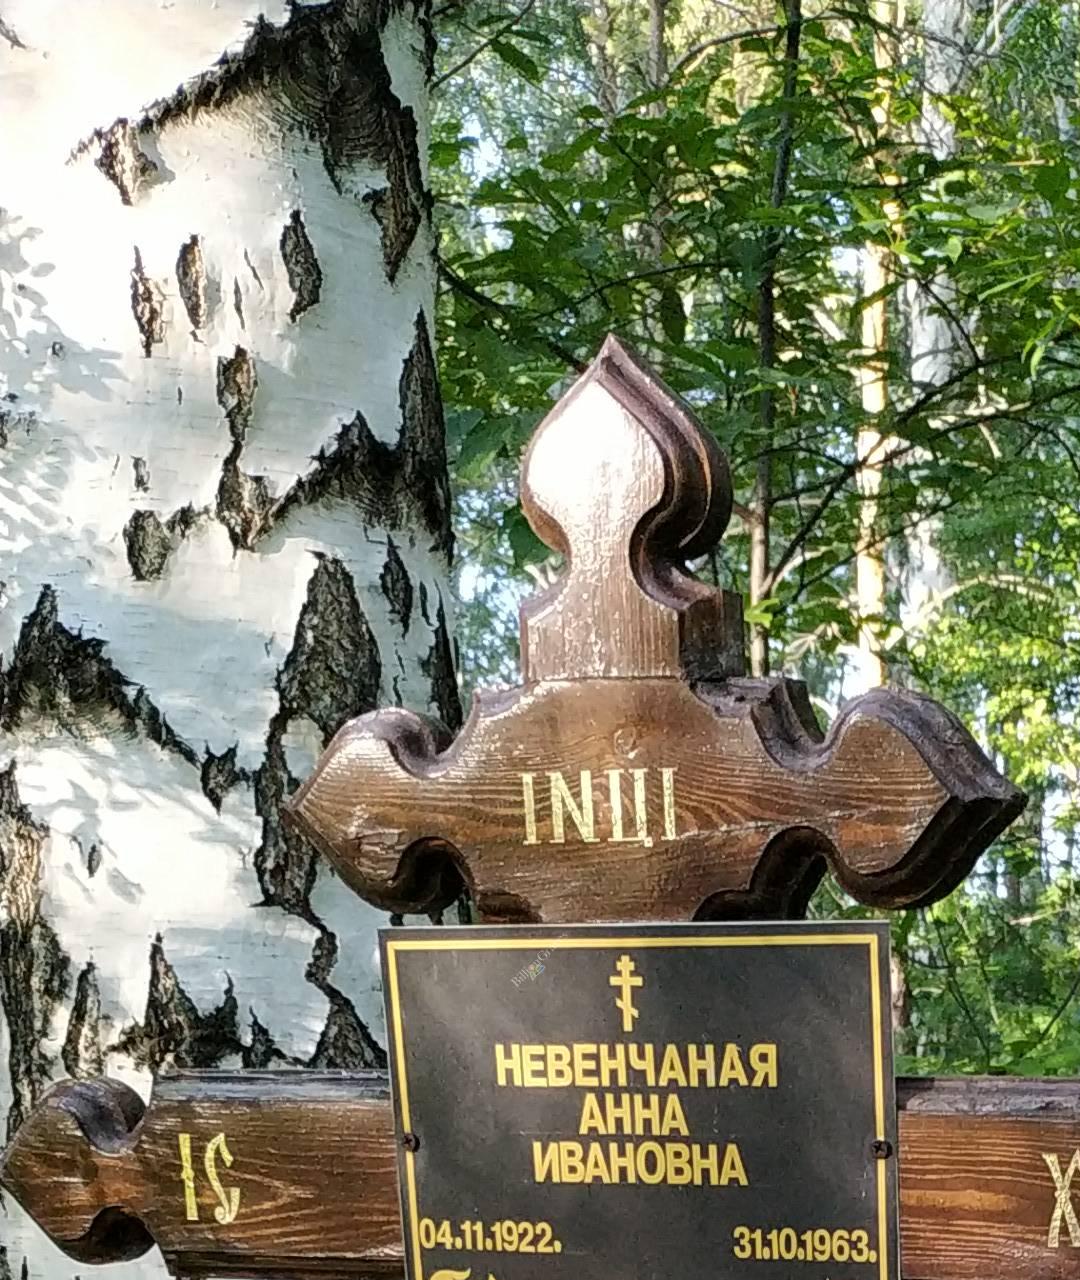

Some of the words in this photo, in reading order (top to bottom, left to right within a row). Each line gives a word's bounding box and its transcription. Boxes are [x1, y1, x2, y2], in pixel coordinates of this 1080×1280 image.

[495, 1043, 778, 1088] НЕВЕНЧАНАЯ
[578, 1092, 689, 1136] АННА
[532, 1140, 748, 1186] ИВАНОВНА
[419, 1216, 562, 1254] 04.11.1922.
[733, 1225, 878, 1264] 31.10.1963.
